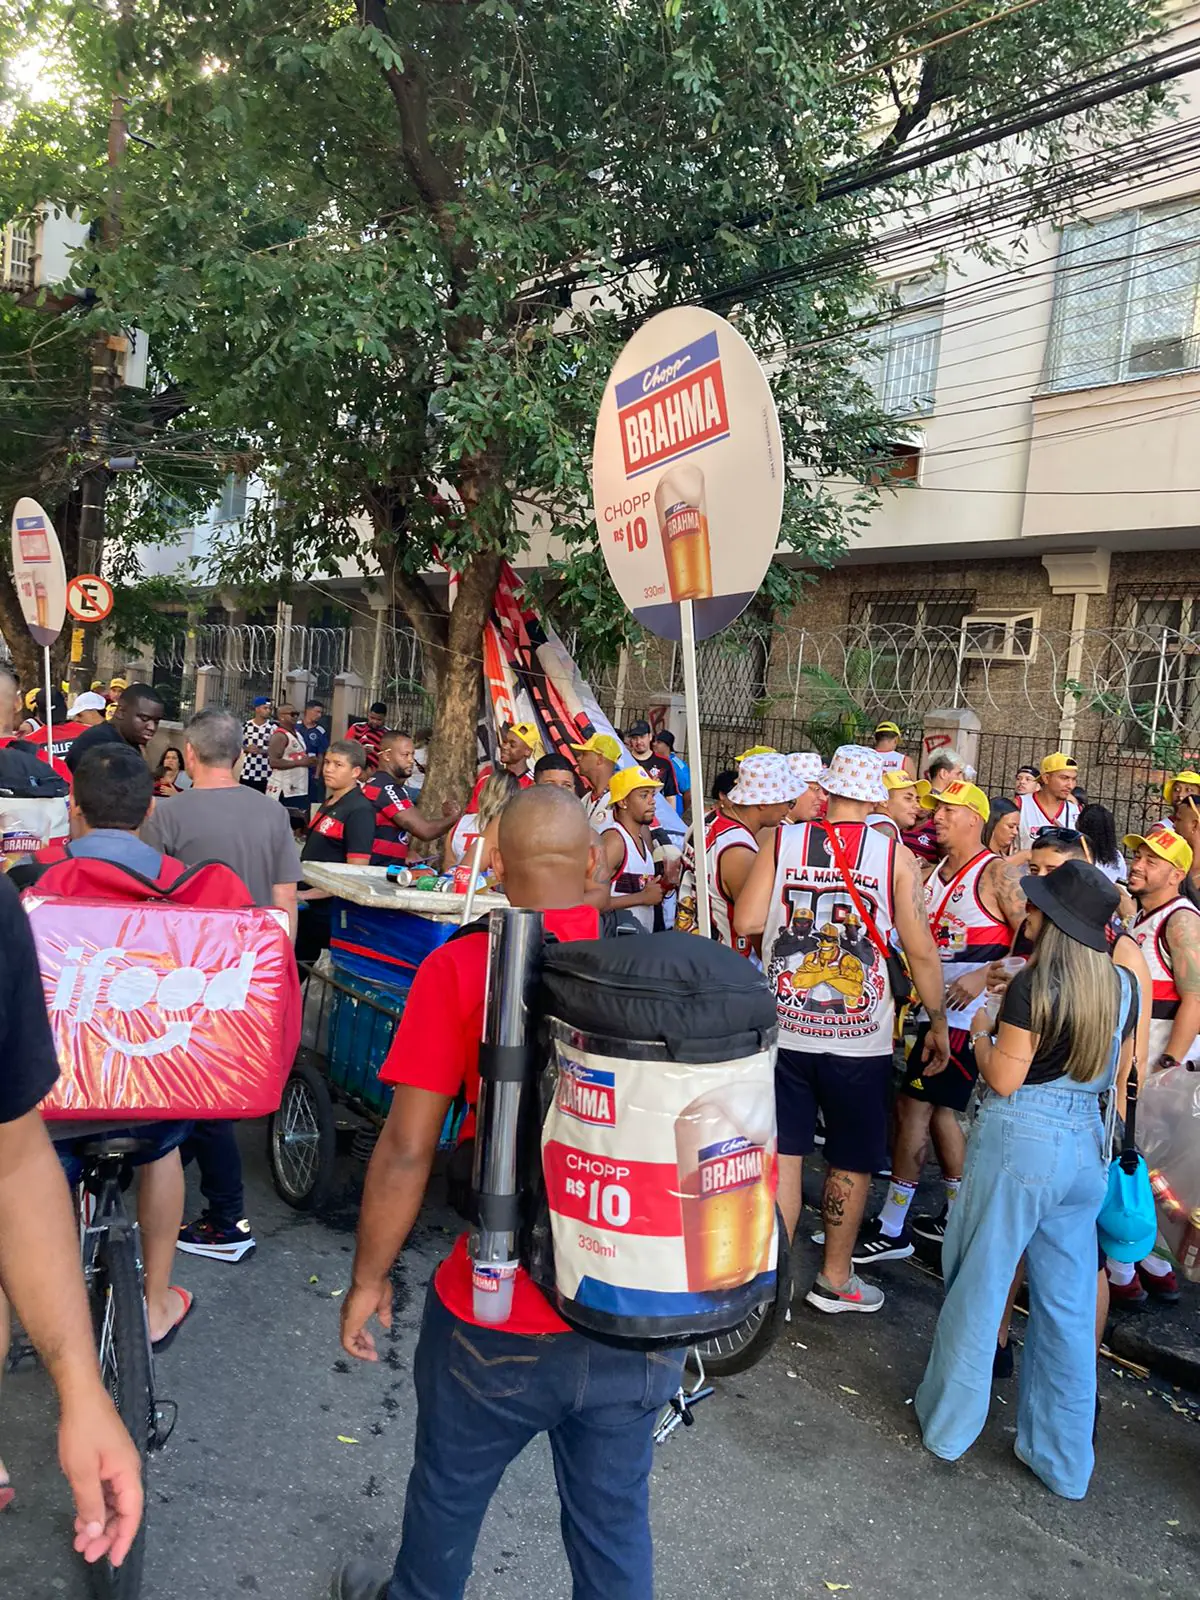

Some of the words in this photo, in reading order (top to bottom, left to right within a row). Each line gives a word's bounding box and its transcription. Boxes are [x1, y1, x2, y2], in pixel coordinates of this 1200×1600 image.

[642, 355, 691, 392] Chopp
[624, 376, 721, 464] BRAHMA
[604, 491, 651, 522] CHOPP
[626, 516, 648, 552] 10
[667, 512, 700, 538] BRAHMA
[81, 584, 98, 611] E
[644, 584, 666, 599] 330ml
[3, 839, 41, 851] BRAHMA
[785, 868, 809, 881] FLA
[779, 1019, 834, 1037] ELFORD
[838, 1022, 879, 1038] ROXO
[566, 1153, 630, 1181] CHOPP
[702, 1151, 762, 1193] BRAHMA
[565, 1177, 586, 1198] R$
[588, 1179, 631, 1227] 10
[578, 1234, 616, 1258] 330ml
